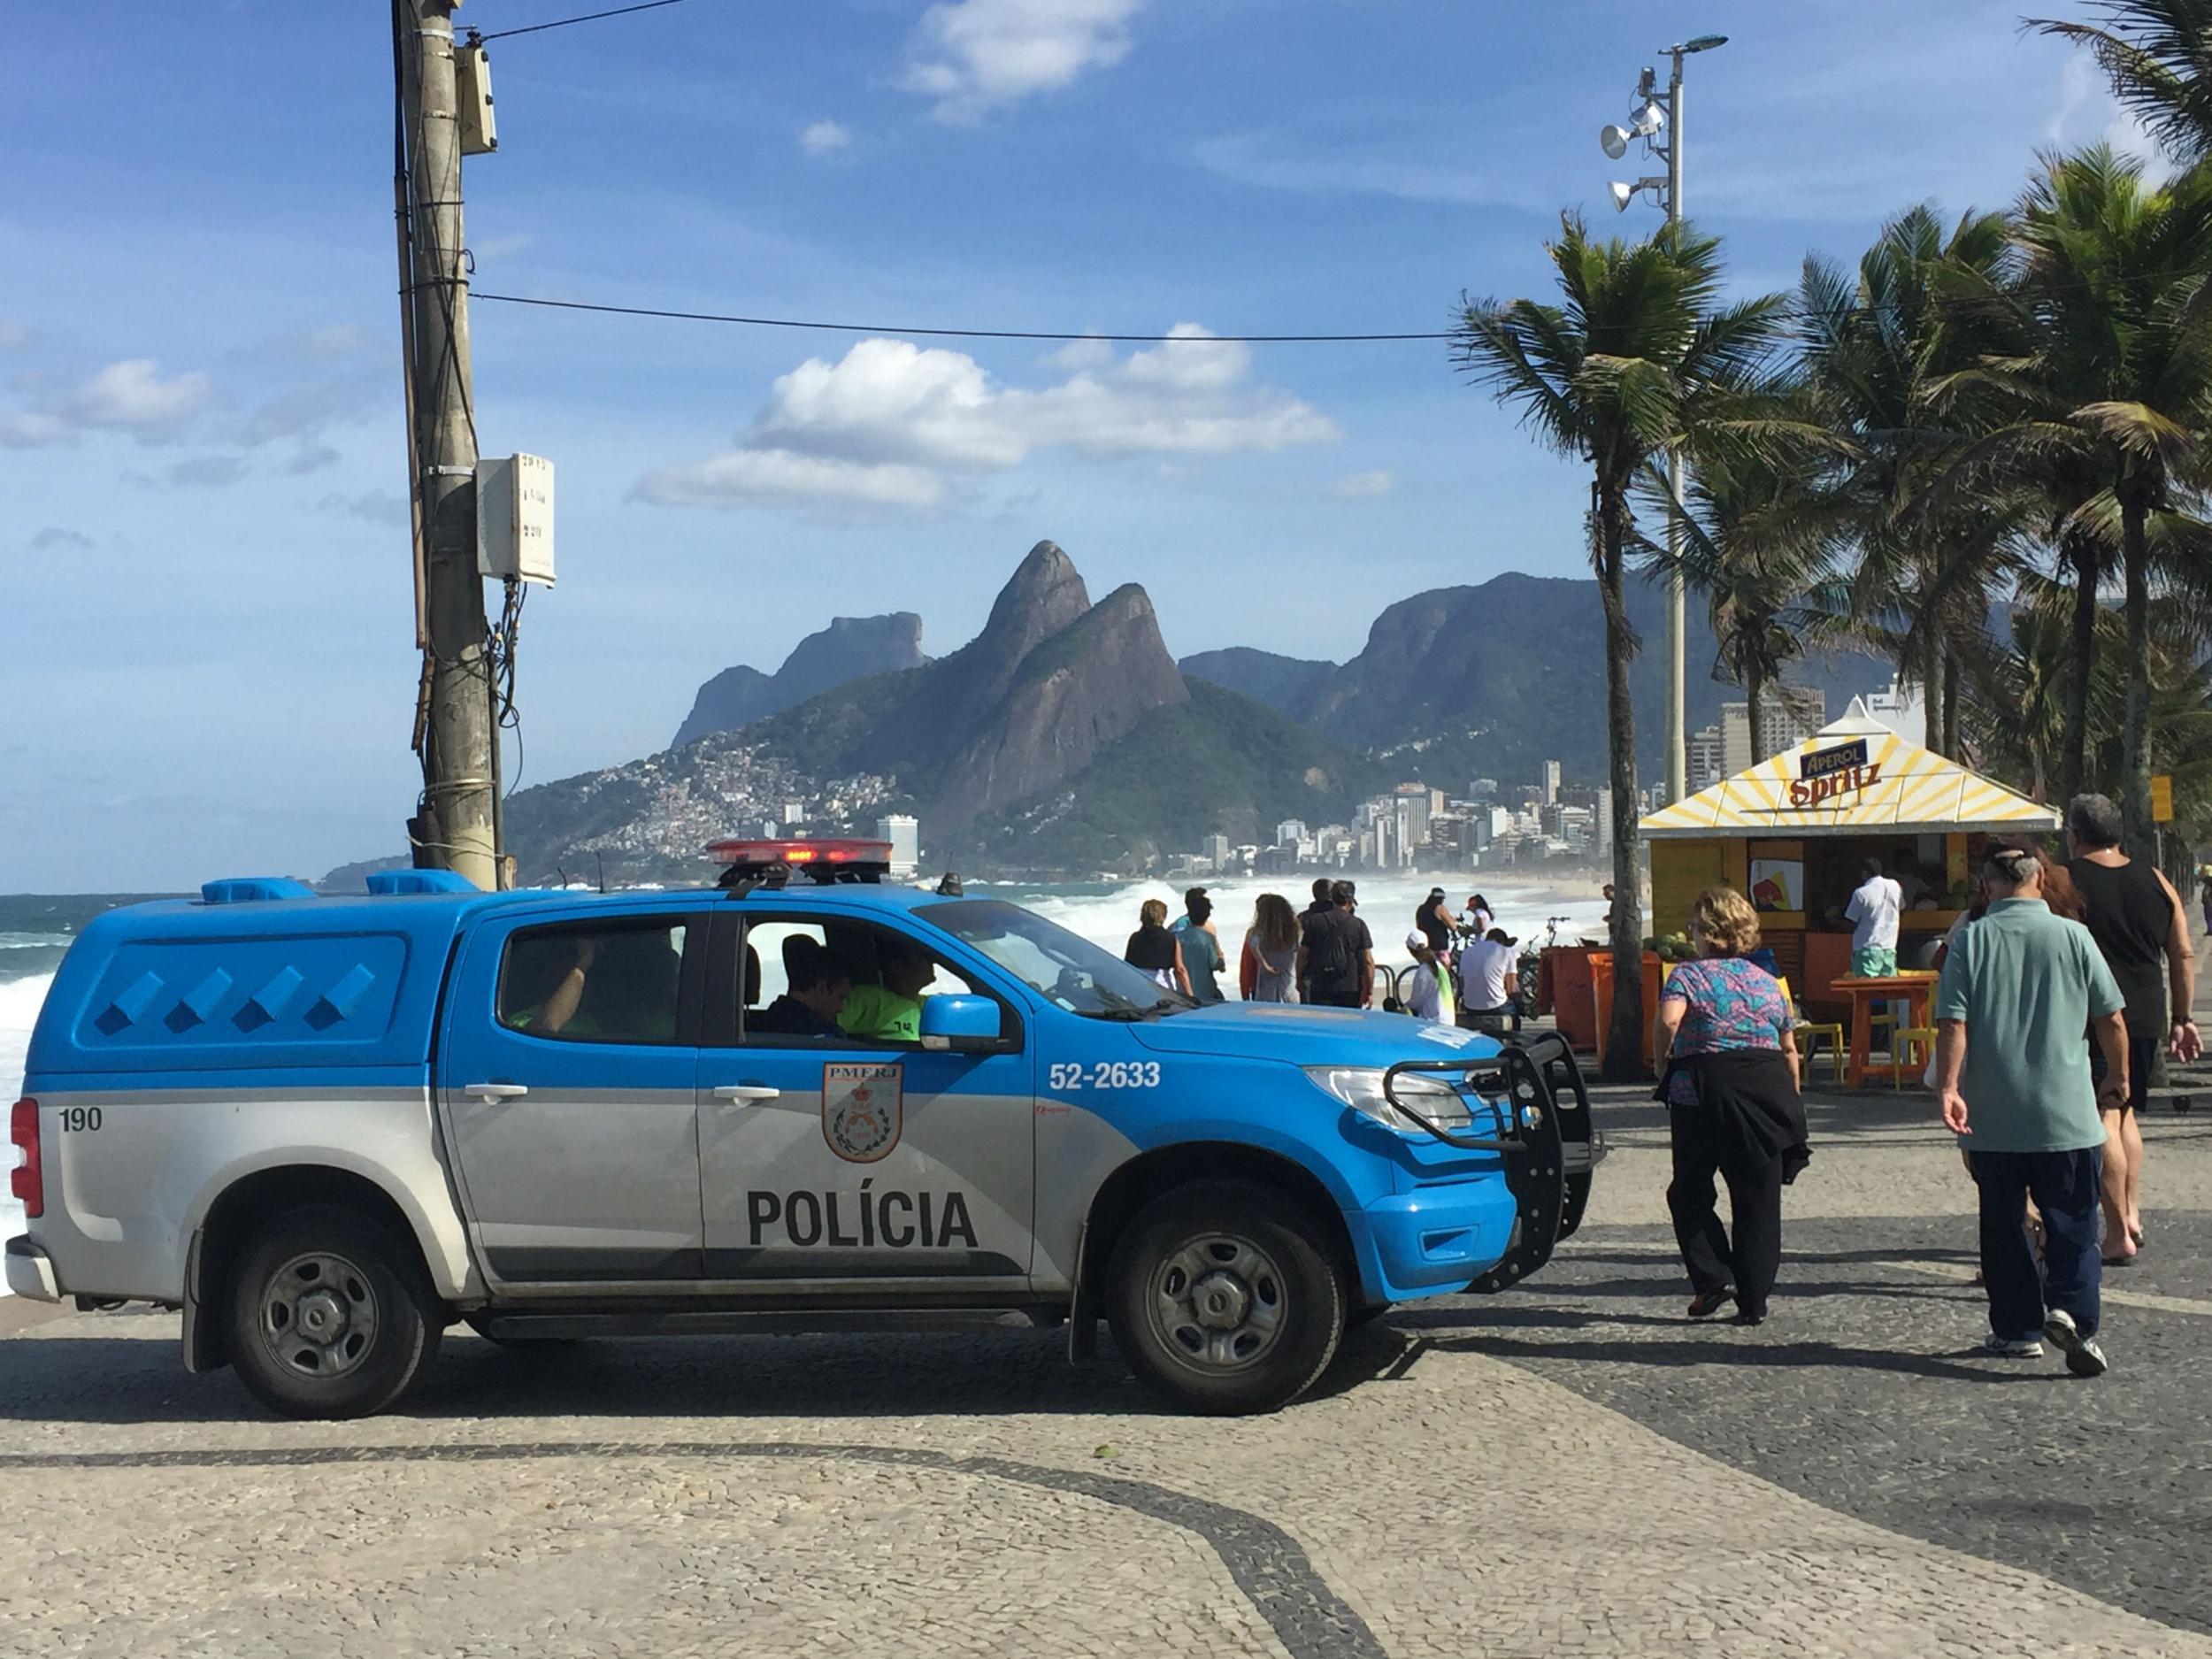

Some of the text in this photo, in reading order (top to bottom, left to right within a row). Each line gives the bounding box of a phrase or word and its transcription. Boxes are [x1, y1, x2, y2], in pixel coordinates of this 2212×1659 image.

[1807, 747, 1862, 775] APEROL
[1789, 762, 1882, 808] Spritz
[830, 1067, 898, 1078] PMERJ
[1049, 1061, 1161, 1090] 52-2633
[58, 1107, 102, 1133] 190
[747, 1178, 979, 1248] POLÍCIA
